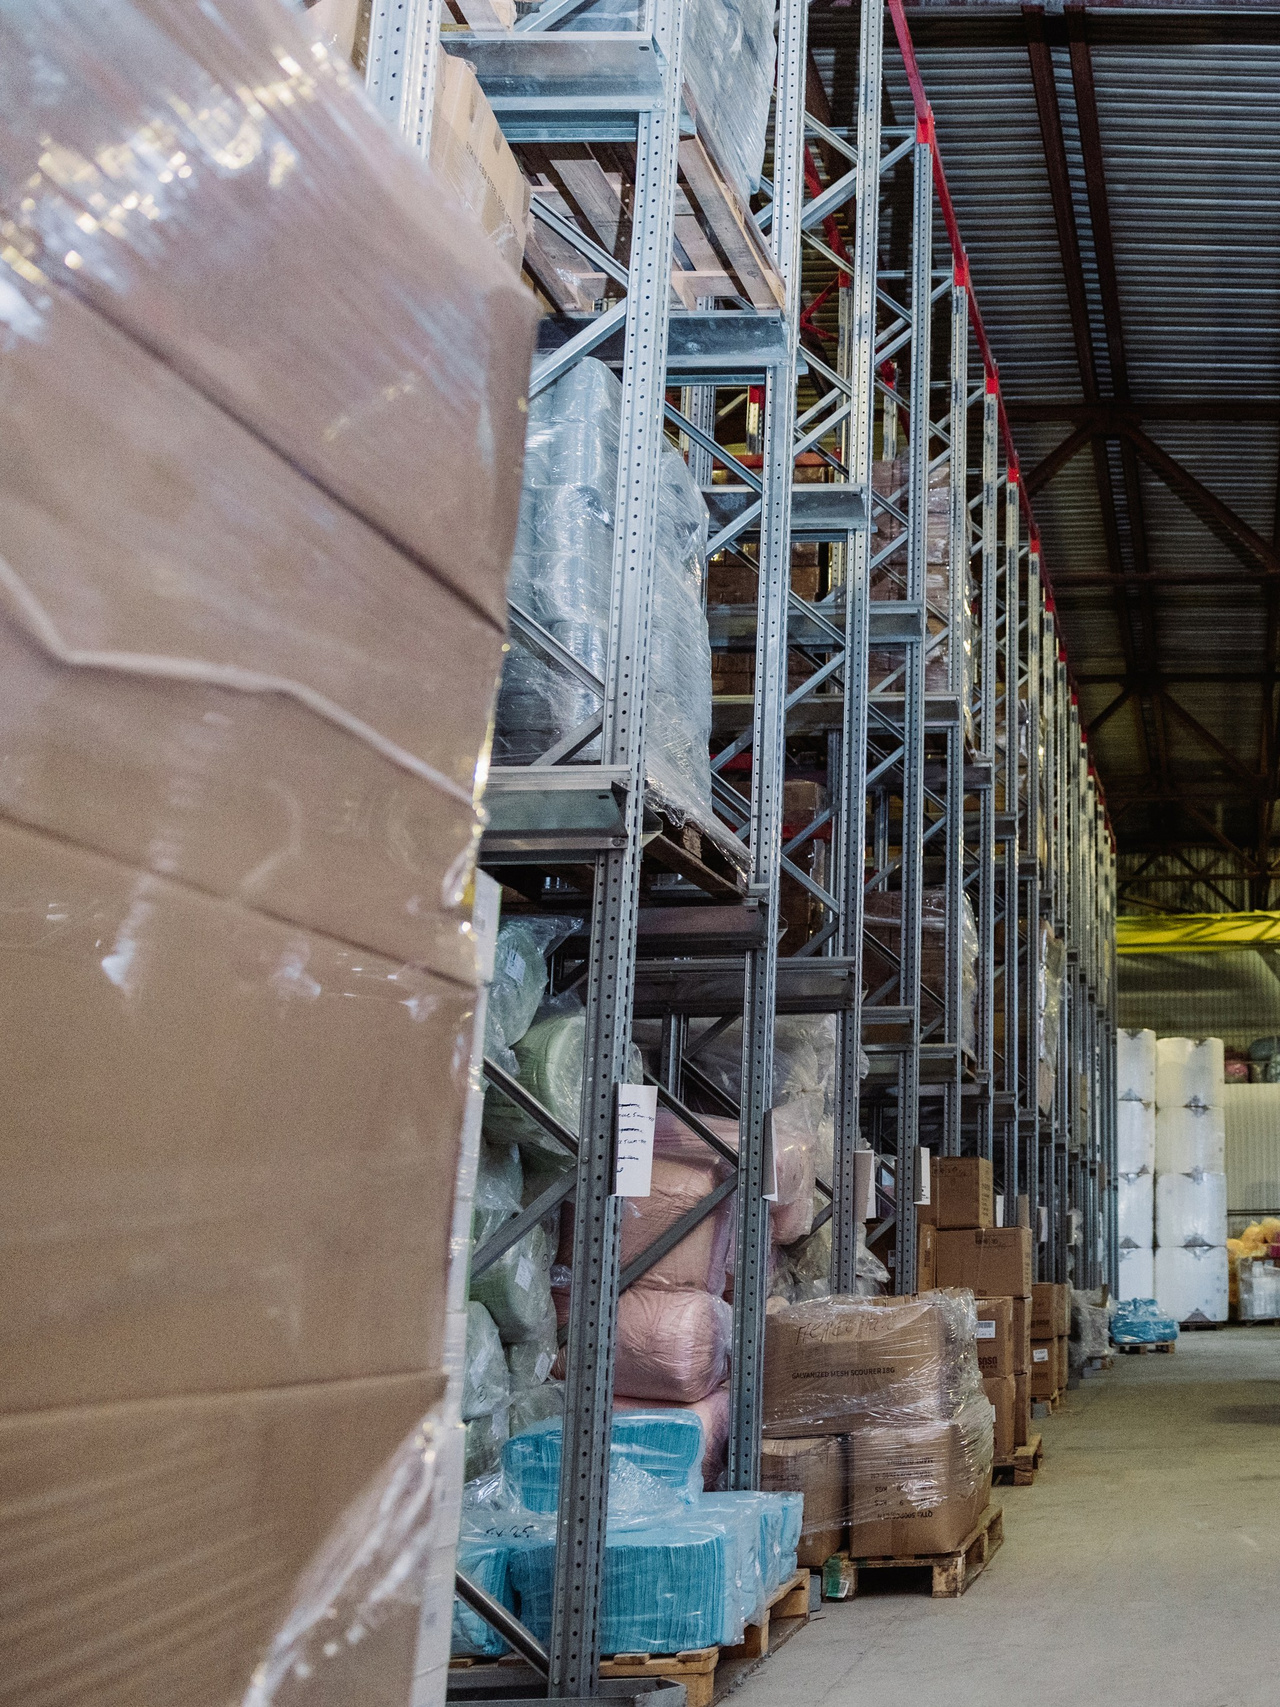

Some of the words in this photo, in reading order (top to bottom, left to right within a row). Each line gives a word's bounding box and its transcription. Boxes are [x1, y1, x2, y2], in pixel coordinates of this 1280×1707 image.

[791, 1370, 829, 1379] GALVANIZED
[830, 1369, 848, 1377] MESH
[850, 1367, 880, 1376] SCOURER
[882, 1366, 894, 1374] 18G
